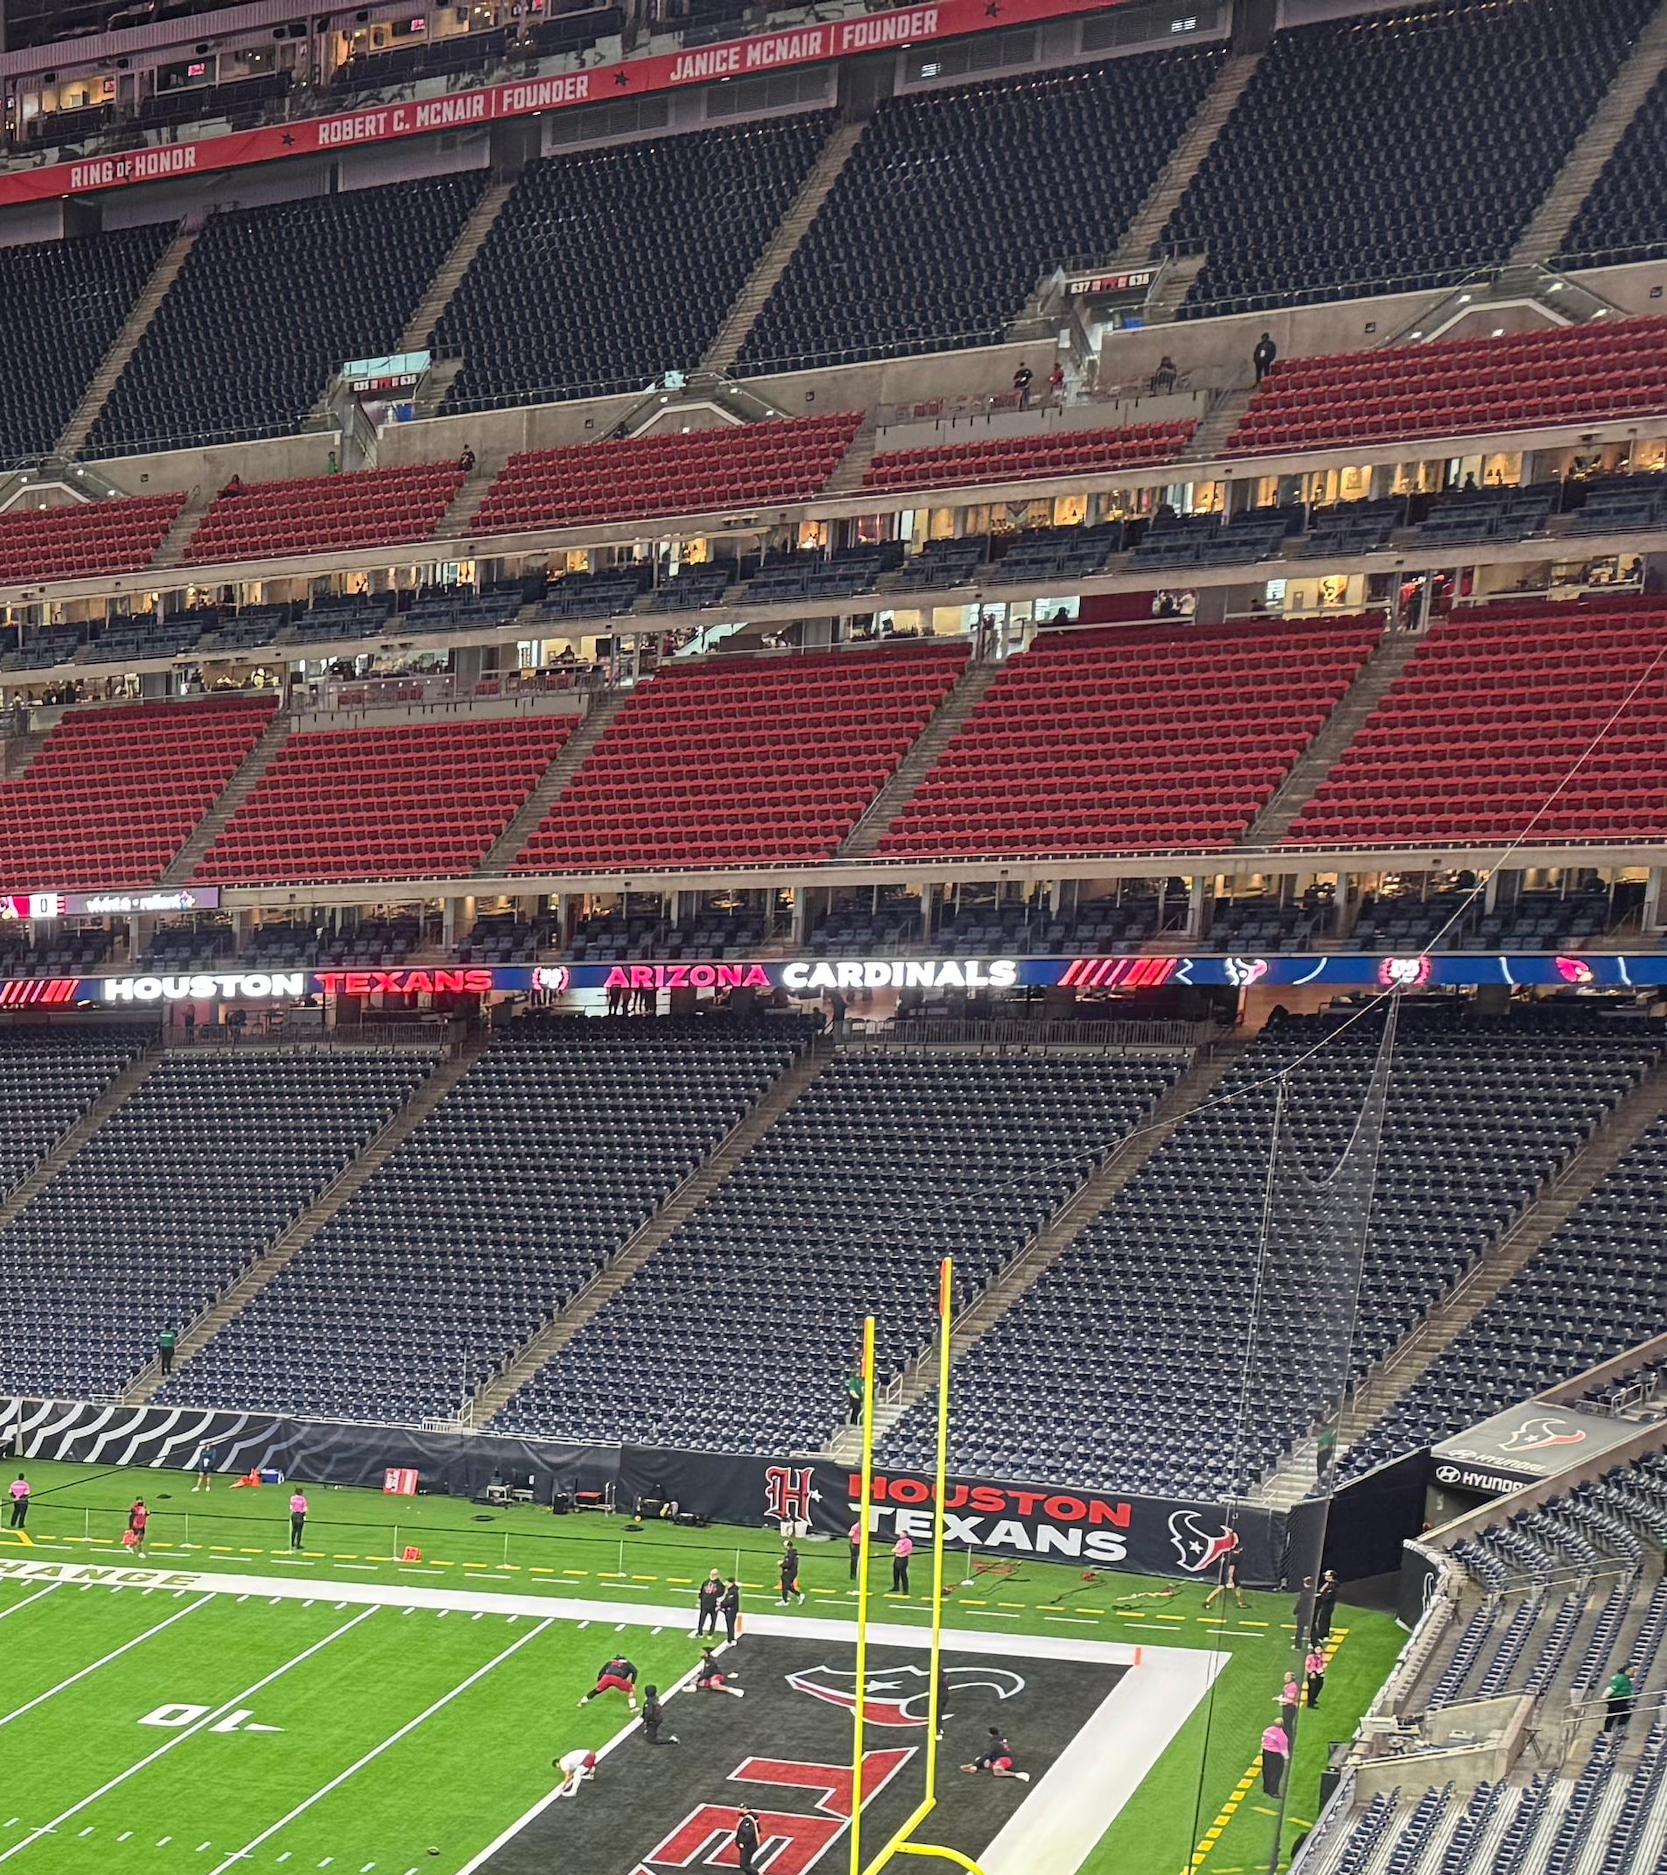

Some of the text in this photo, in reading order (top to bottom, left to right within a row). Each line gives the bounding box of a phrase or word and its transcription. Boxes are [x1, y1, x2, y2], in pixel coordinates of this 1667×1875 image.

[669, 9, 938, 83] JANICE MCNAIR FOUNDER
[317, 75, 589, 146] ROBERT C. MCNAIR FOUNDER
[70, 146, 197, 188] RING OF HONOR
[104, 968, 494, 1002] HOUSTON TEXANS
[602, 959, 1017, 990] ARIZONA CARDINALS
[1463, 1471, 1531, 1493] HYUNDA
[1474, 1454, 1547, 1473] HYUNDAI
[848, 1472, 1132, 1529] HOUSTON
[848, 1503, 1128, 1562] TEXANS
